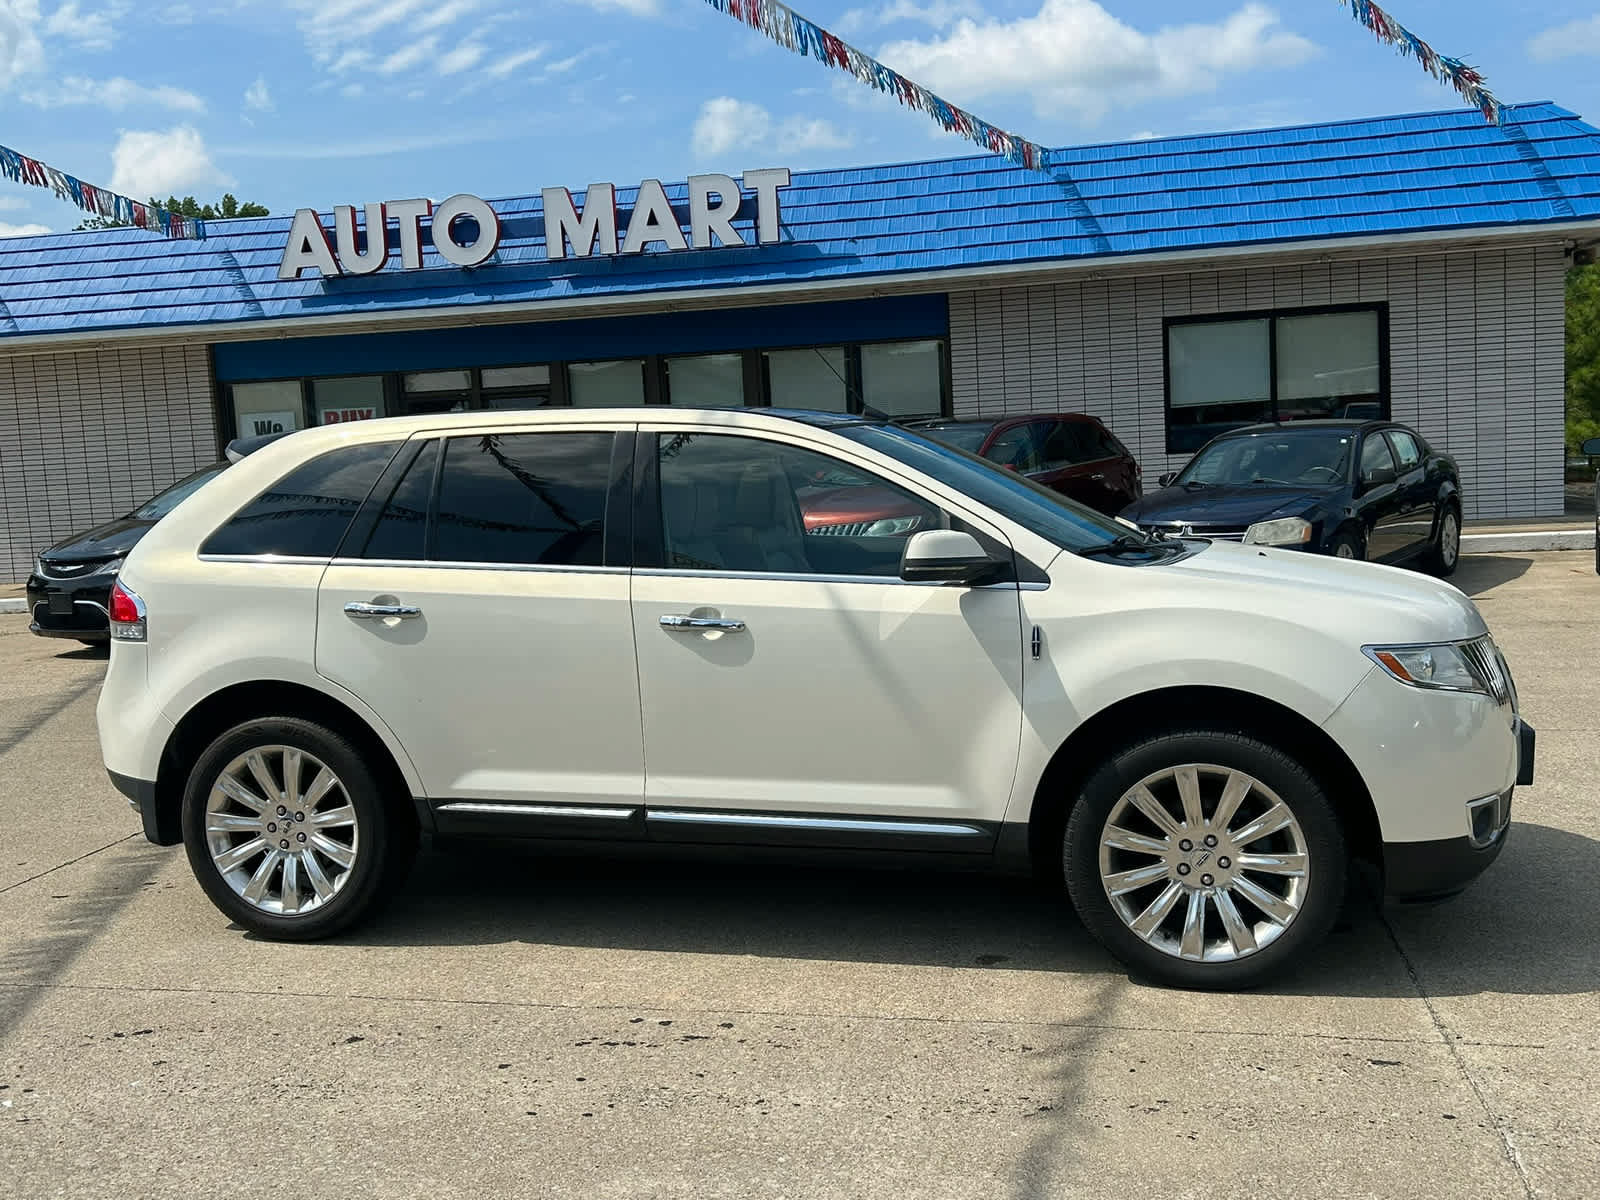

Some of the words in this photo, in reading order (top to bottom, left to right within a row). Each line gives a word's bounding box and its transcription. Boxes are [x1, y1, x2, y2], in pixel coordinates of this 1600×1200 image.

[278, 193, 500, 279] AUTO
[541, 168, 790, 259] MART
[254, 420, 283, 436] We
